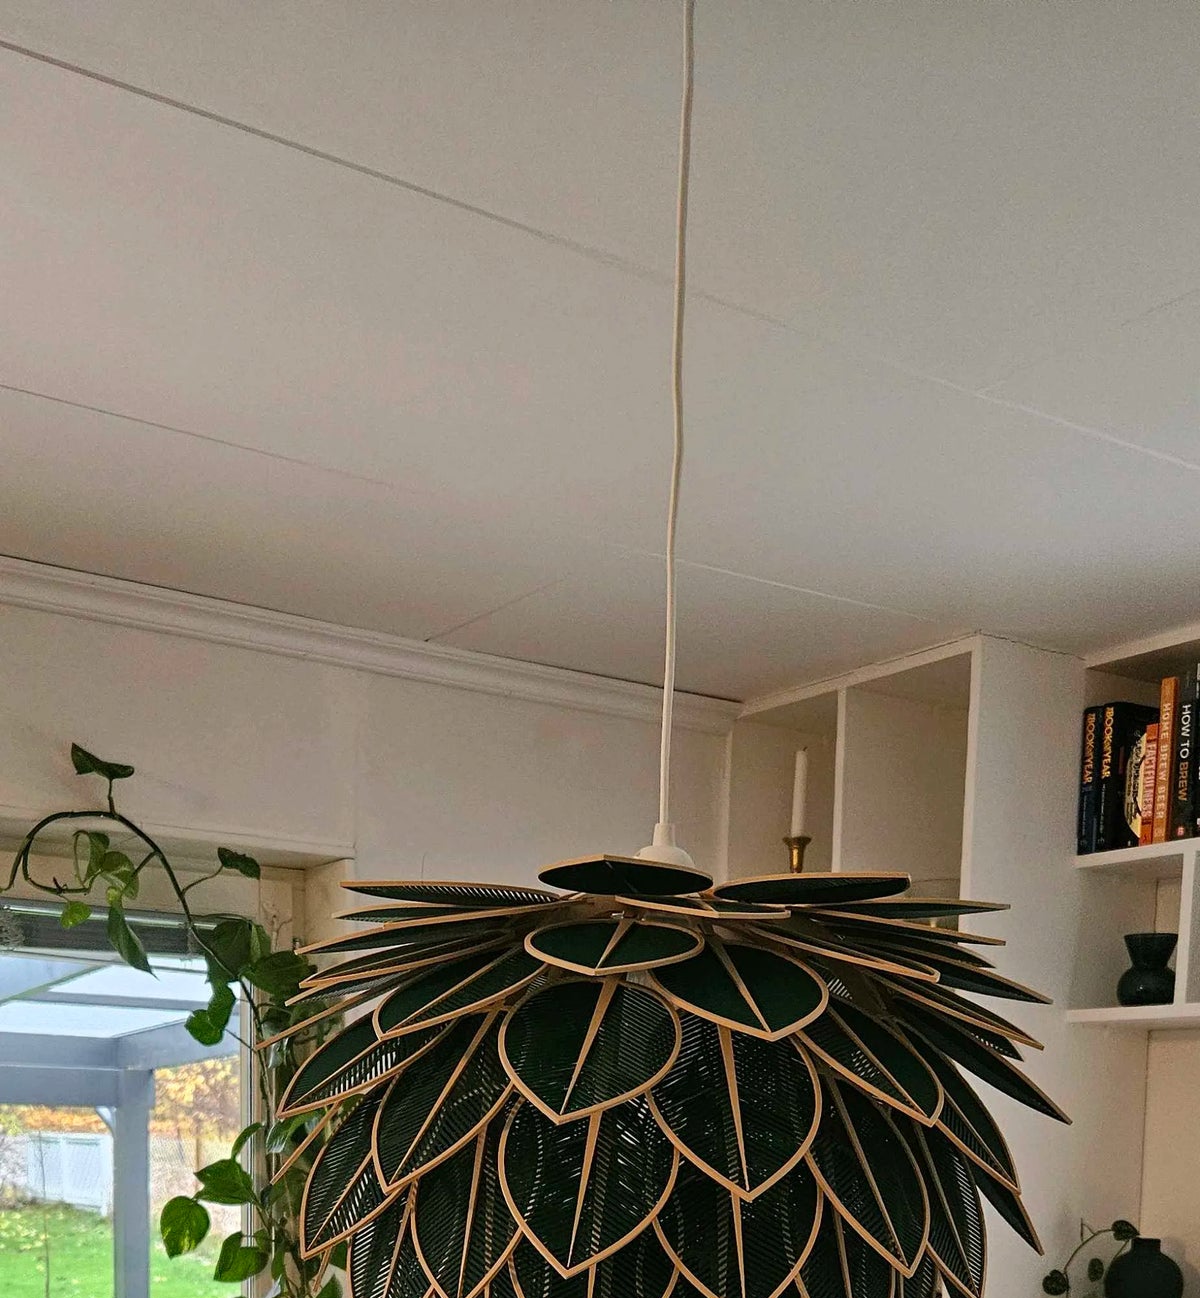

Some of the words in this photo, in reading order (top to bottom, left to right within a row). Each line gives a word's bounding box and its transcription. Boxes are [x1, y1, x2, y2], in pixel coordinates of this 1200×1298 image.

[1104, 710, 1114, 743] BOOK
[1160, 703, 1171, 740] HOME
[1181, 704, 1192, 737] HOW
[1101, 749, 1112, 780] YEAR
[1158, 744, 1169, 782] BREW
[1179, 740, 1190, 759] TO
[1082, 755, 1093, 785] YEAR
[1141, 741, 1157, 819] FACTFULNESS
[1178, 761, 1189, 801] BREW
[1156, 785, 1166, 819] BEER
